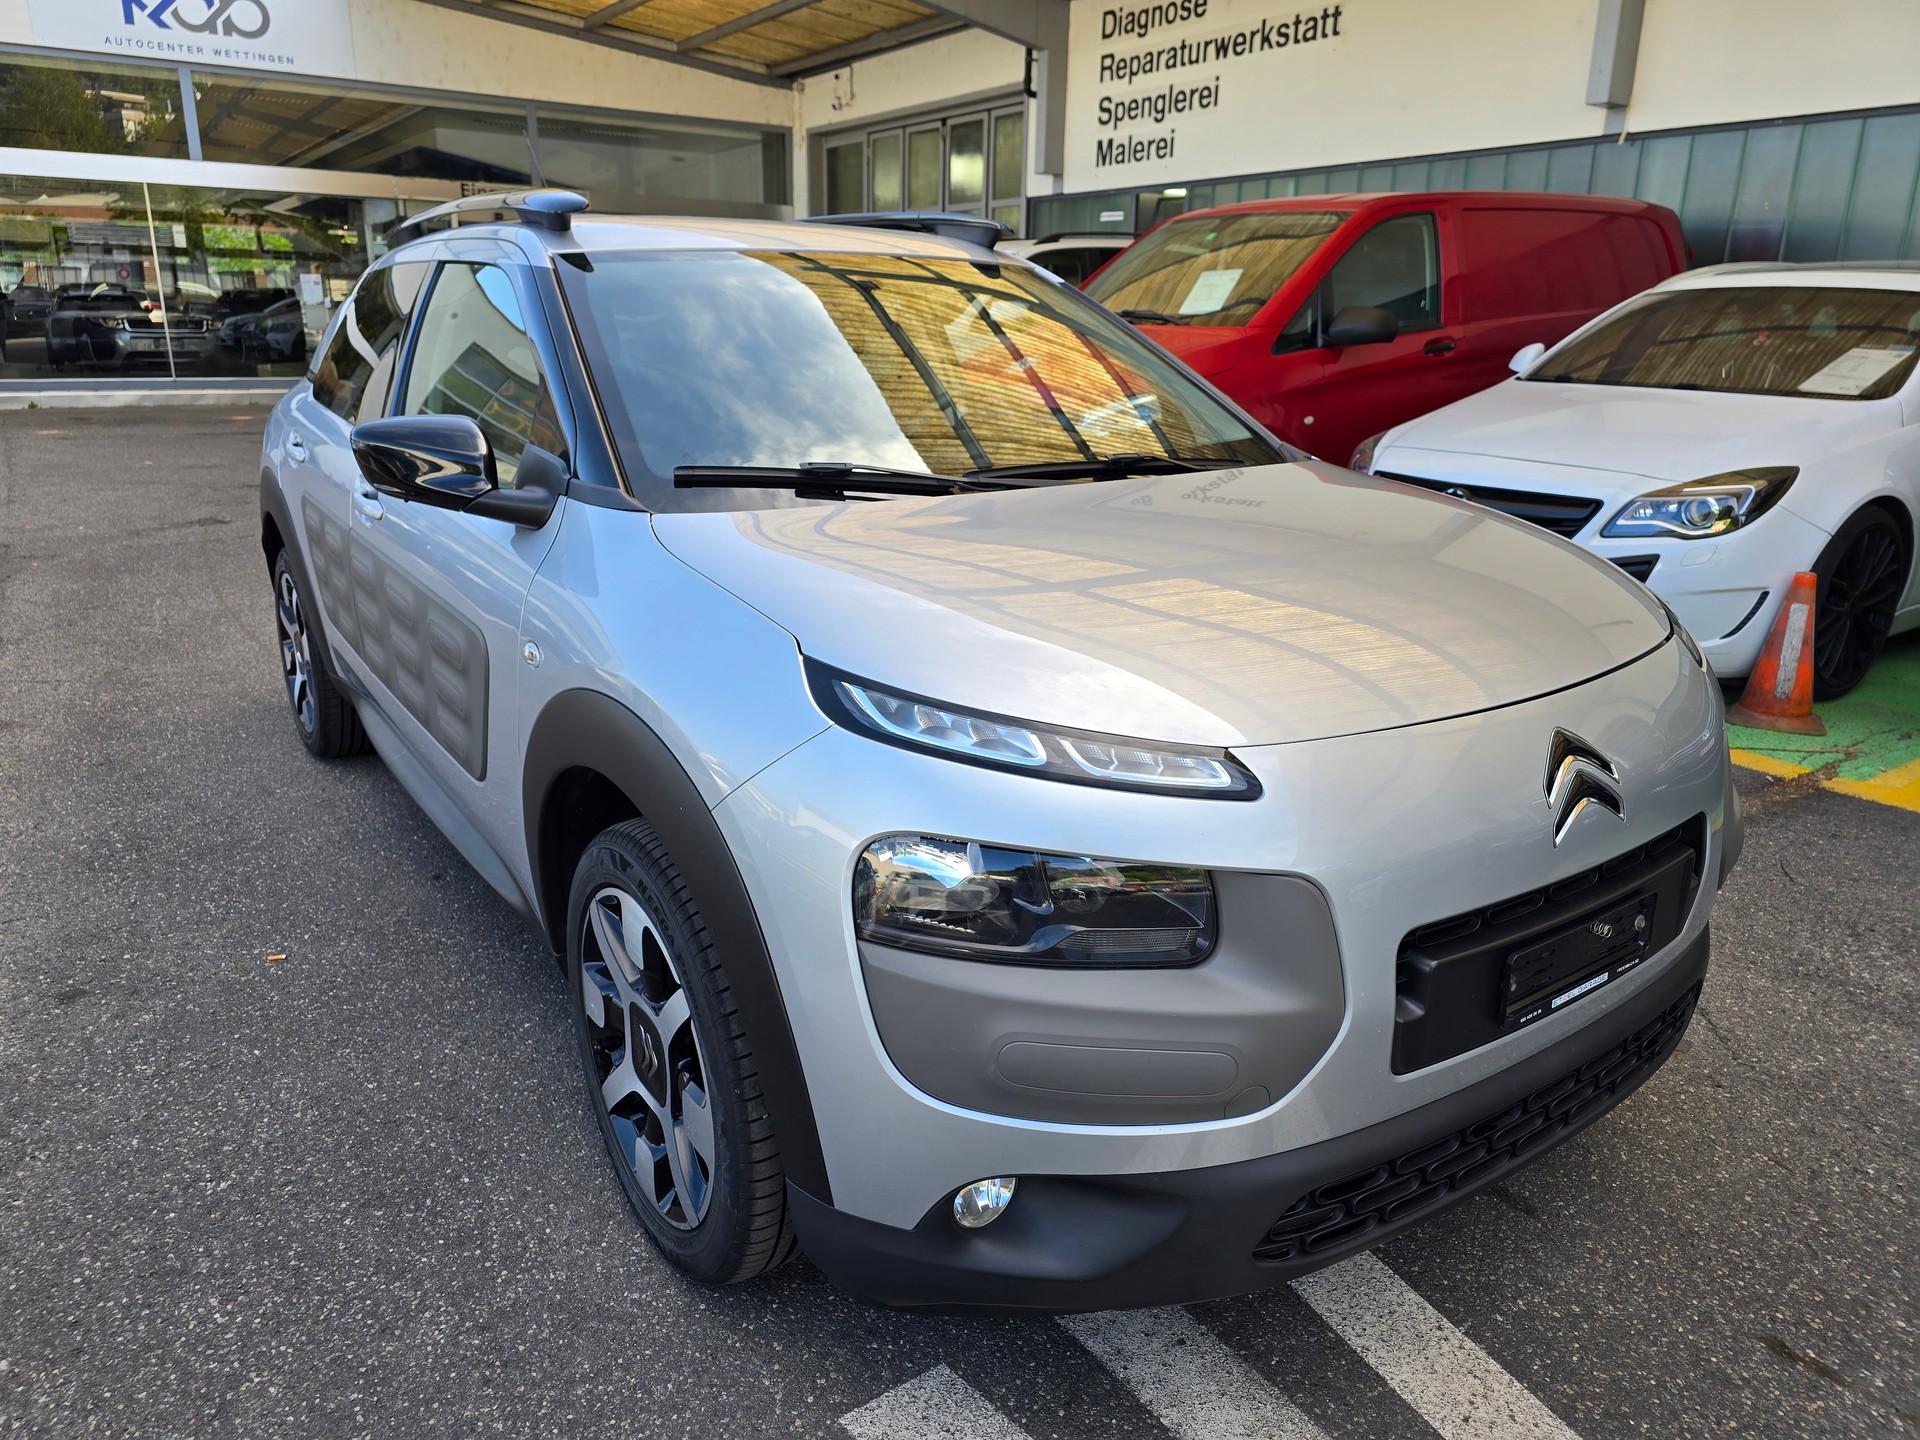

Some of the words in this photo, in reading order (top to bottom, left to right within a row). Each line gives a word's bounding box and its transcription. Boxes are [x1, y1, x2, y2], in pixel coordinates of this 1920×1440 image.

[1101, 0, 1207, 40] Diagnose
[104, 36, 204, 55] AUTOCENTER
[212, 48, 295, 65] WETTINGEN
[1099, 5, 1342, 84] Reparaturwerkstatt
[1098, 76, 1220, 130] Spenglerei
[1096, 129, 1175, 168] Malerei
